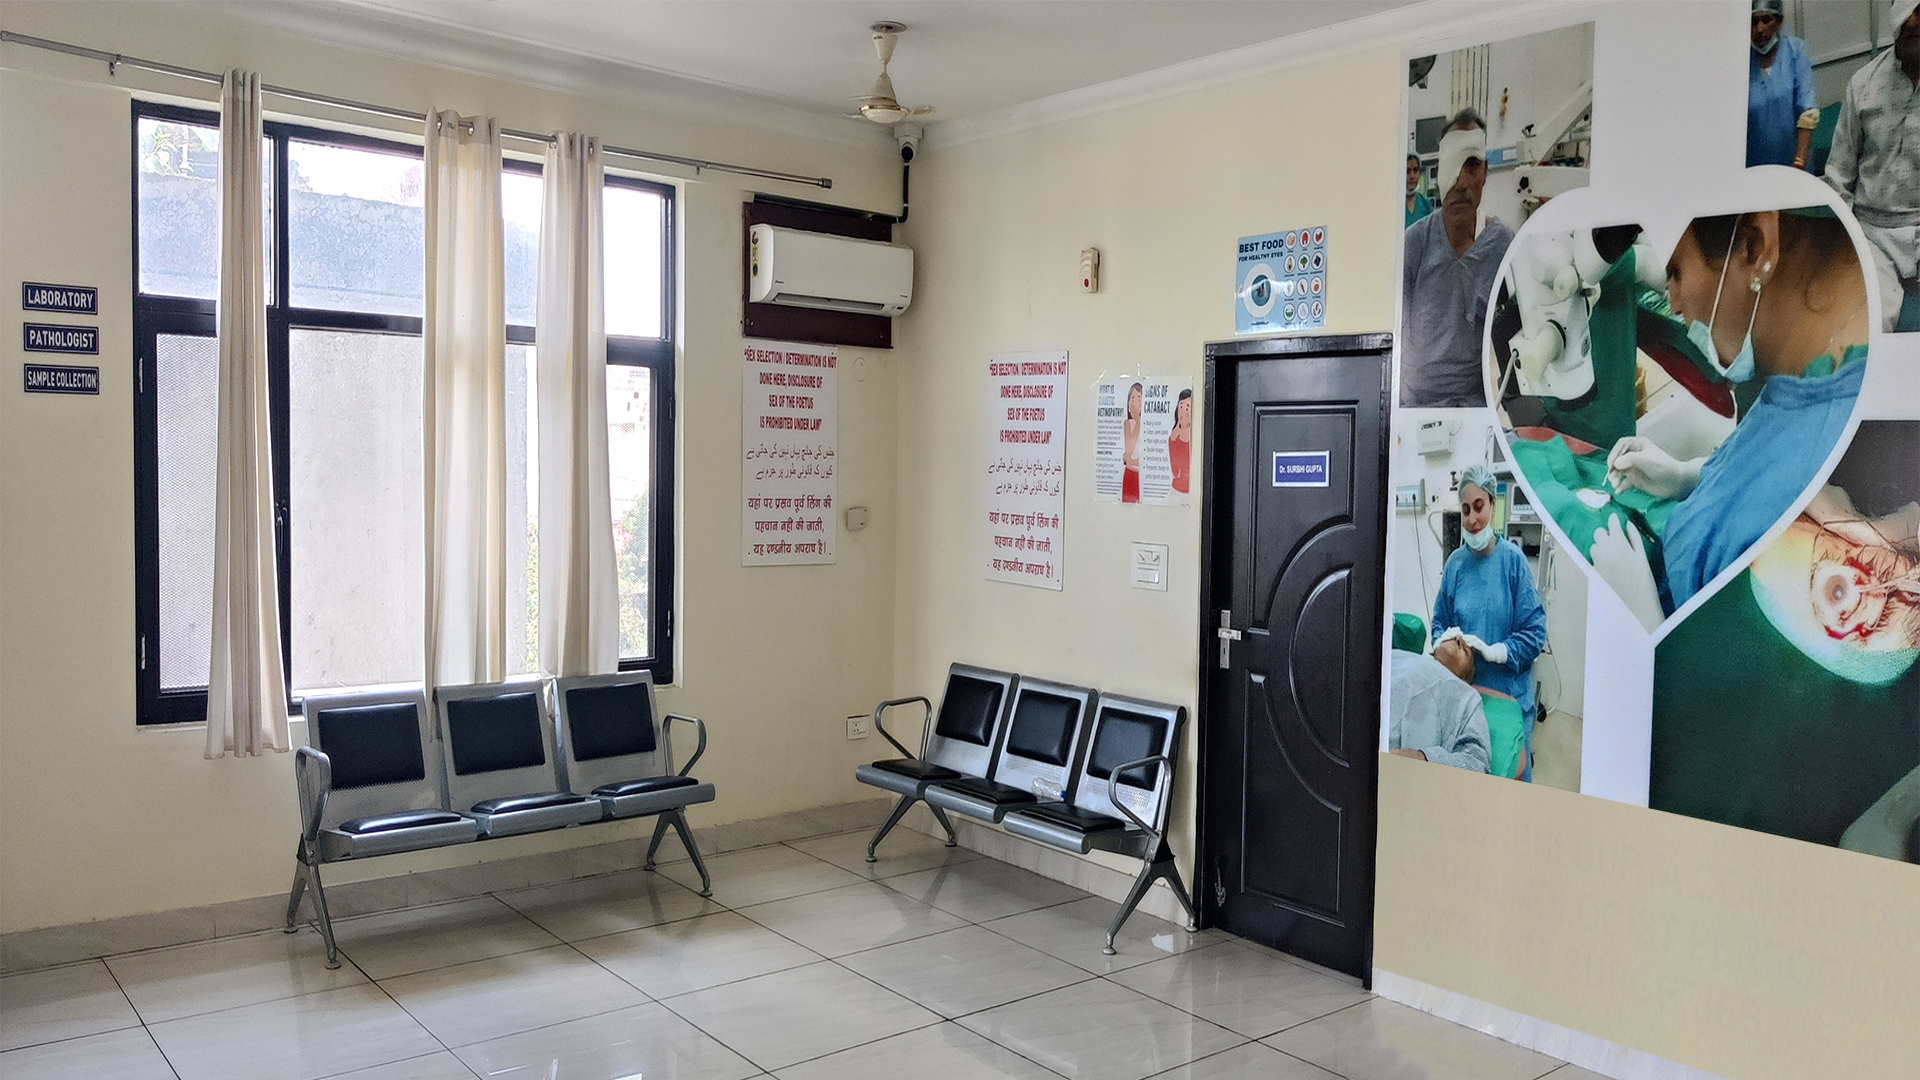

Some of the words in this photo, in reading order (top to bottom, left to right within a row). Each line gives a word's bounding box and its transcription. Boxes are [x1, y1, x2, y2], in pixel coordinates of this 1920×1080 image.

[1239, 242, 1259, 253] BEST
[1261, 239, 1284, 250] FOOD
[1248, 252, 1270, 261] HEALTHY
[28, 289, 94, 308] LABORATORY
[29, 329, 94, 348] PATHOLOGIST
[756, 349, 783, 364] SELECTION
[785, 352, 822, 368] DETERMINATION
[822, 355, 827, 368] IS
[827, 355, 837, 369] NOT
[998, 362, 1019, 376] SELECTION
[1021, 362, 1052, 376] DETERMINATION
[1058, 361, 1067, 375] NOT
[28, 370, 55, 387] SAMPLE
[56, 371, 97, 388] COLLECTION
[759, 371, 773, 385] DONE
[787, 373, 816, 388] DISCLOSURE
[816, 376, 823, 388] OF
[1000, 385, 1011, 398] DONE
[1023, 385, 1047, 398] DISCLOSURE
[1048, 384, 1054, 398] OF
[1145, 385, 1160, 398] SIGNS
[1161, 385, 1169, 398] OF
[768, 394, 778, 407] SEX
[779, 395, 785, 407] OF
[786, 395, 795, 408] THE
[796, 396, 814, 409] FOETUS
[1144, 401, 1171, 414] CATARACT
[1007, 407, 1015, 420] SEX
[1015, 407, 1021, 420] OF
[1021, 408, 1030, 421] THE
[1029, 408, 1045, 421] FOETUS
[759, 415, 765, 429] IS
[765, 416, 793, 430] PROHIBITED
[794, 417, 809, 430] UNDER
[1004, 429, 1027, 443] PROHIBITED
[1027, 430, 1041, 444] UNDER
[1286, 465, 1305, 474] SURBHI
[1305, 465, 1323, 474] GUPTA
[763, 498, 773, 509] पर
[775, 498, 792, 510] प्रसव
[794, 494, 805, 513] पूर्व
[806, 494, 822, 509] लिंग
[823, 494, 832, 509] की
[755, 521, 778, 533] पहचान
[795, 517, 805, 531] की
[753, 543, 764, 556] यह
[766, 539, 792, 555] दण्डनीय
